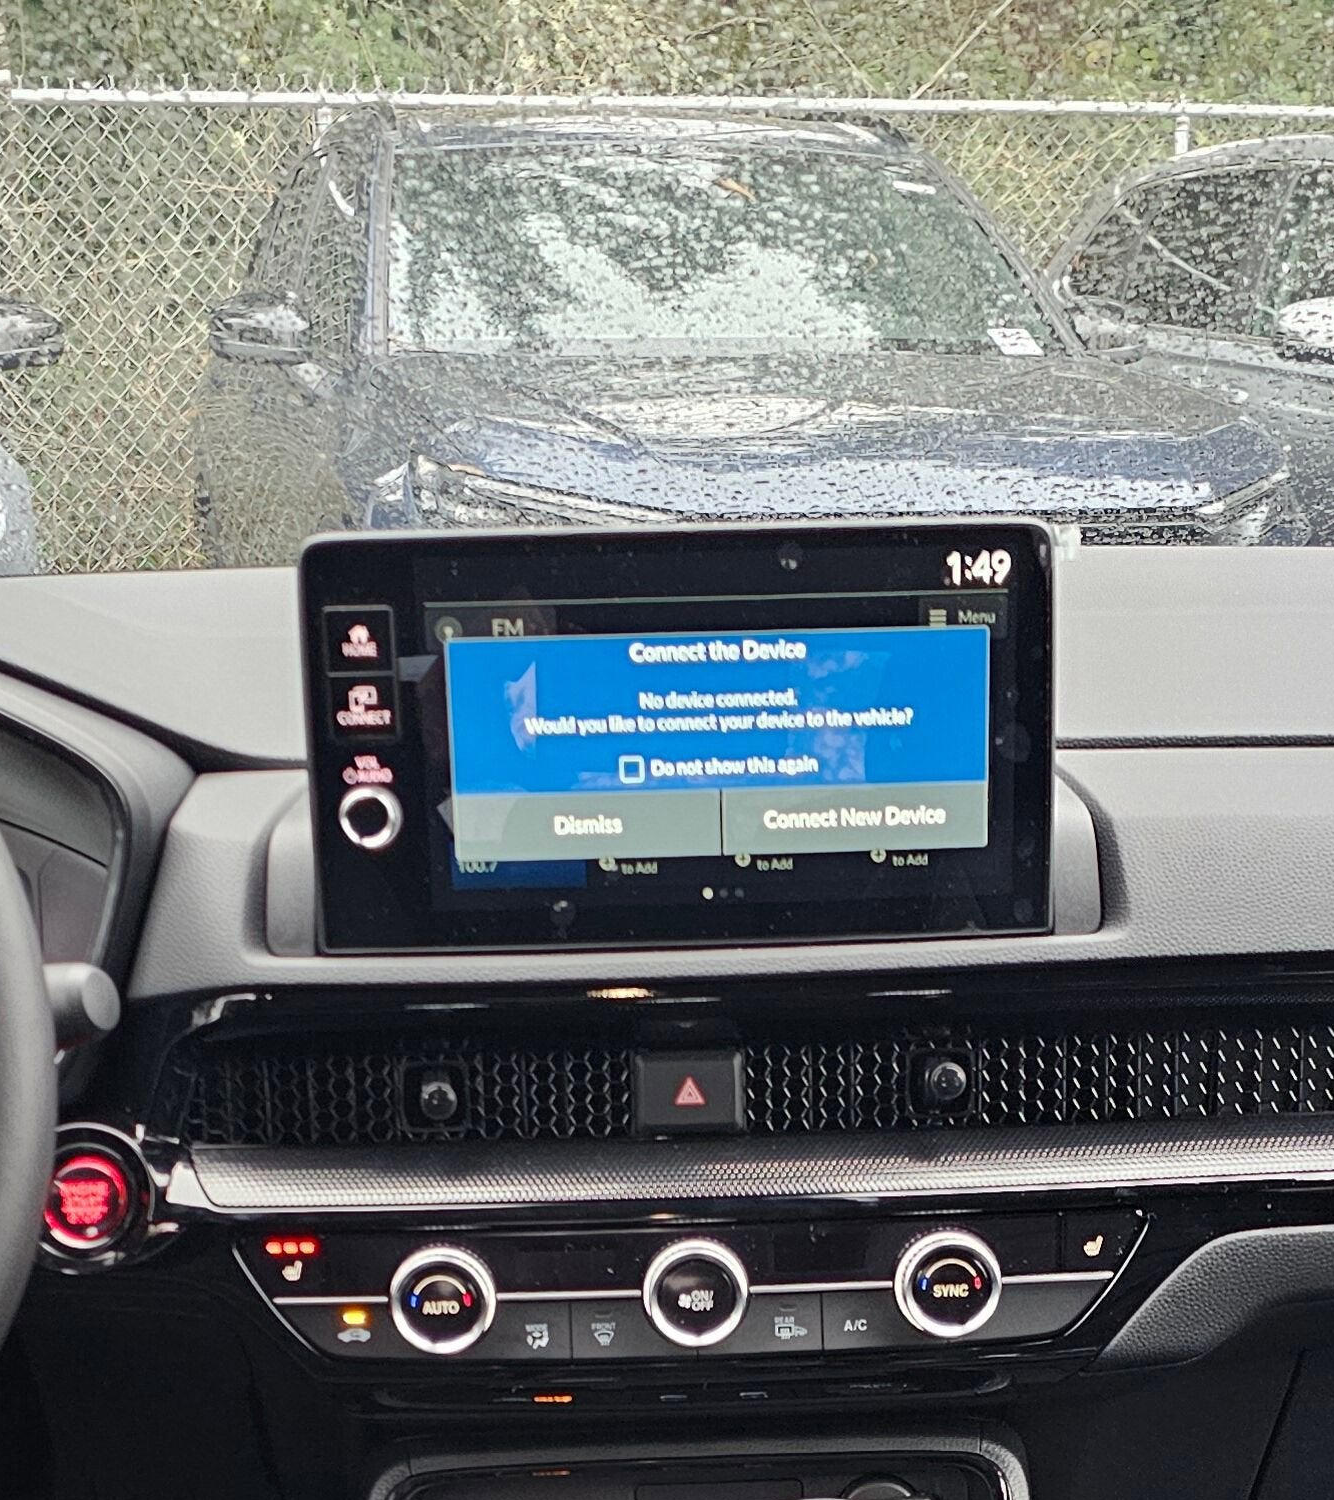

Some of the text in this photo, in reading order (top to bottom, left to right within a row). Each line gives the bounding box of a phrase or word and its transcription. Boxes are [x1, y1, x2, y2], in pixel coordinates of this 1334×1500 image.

[946, 549, 1011, 586] 1:49
[958, 610, 996, 624] Menu
[491, 618, 524, 636] FM
[341, 641, 377, 657] HOME
[628, 637, 807, 663] Connect the Device
[638, 688, 798, 710] No device connected.
[336, 709, 392, 726] CONNECT
[524, 706, 914, 737] Would you like to connect your device to the vehicle?
[650, 754, 820, 777] Do not show this again
[553, 815, 623, 836] Dismiss
[763, 805, 947, 830] Connect New Device
[621, 862, 658, 875] to Add
[756, 858, 794, 871] to Add
[892, 854, 929, 867] to Add
[691, 1290, 714, 1301] ON/
[933, 1283, 969, 1298] SYNC
[422, 1301, 460, 1315] AUTO
[691, 1300, 714, 1312] OFF
[843, 1319, 868, 1332] A/C
